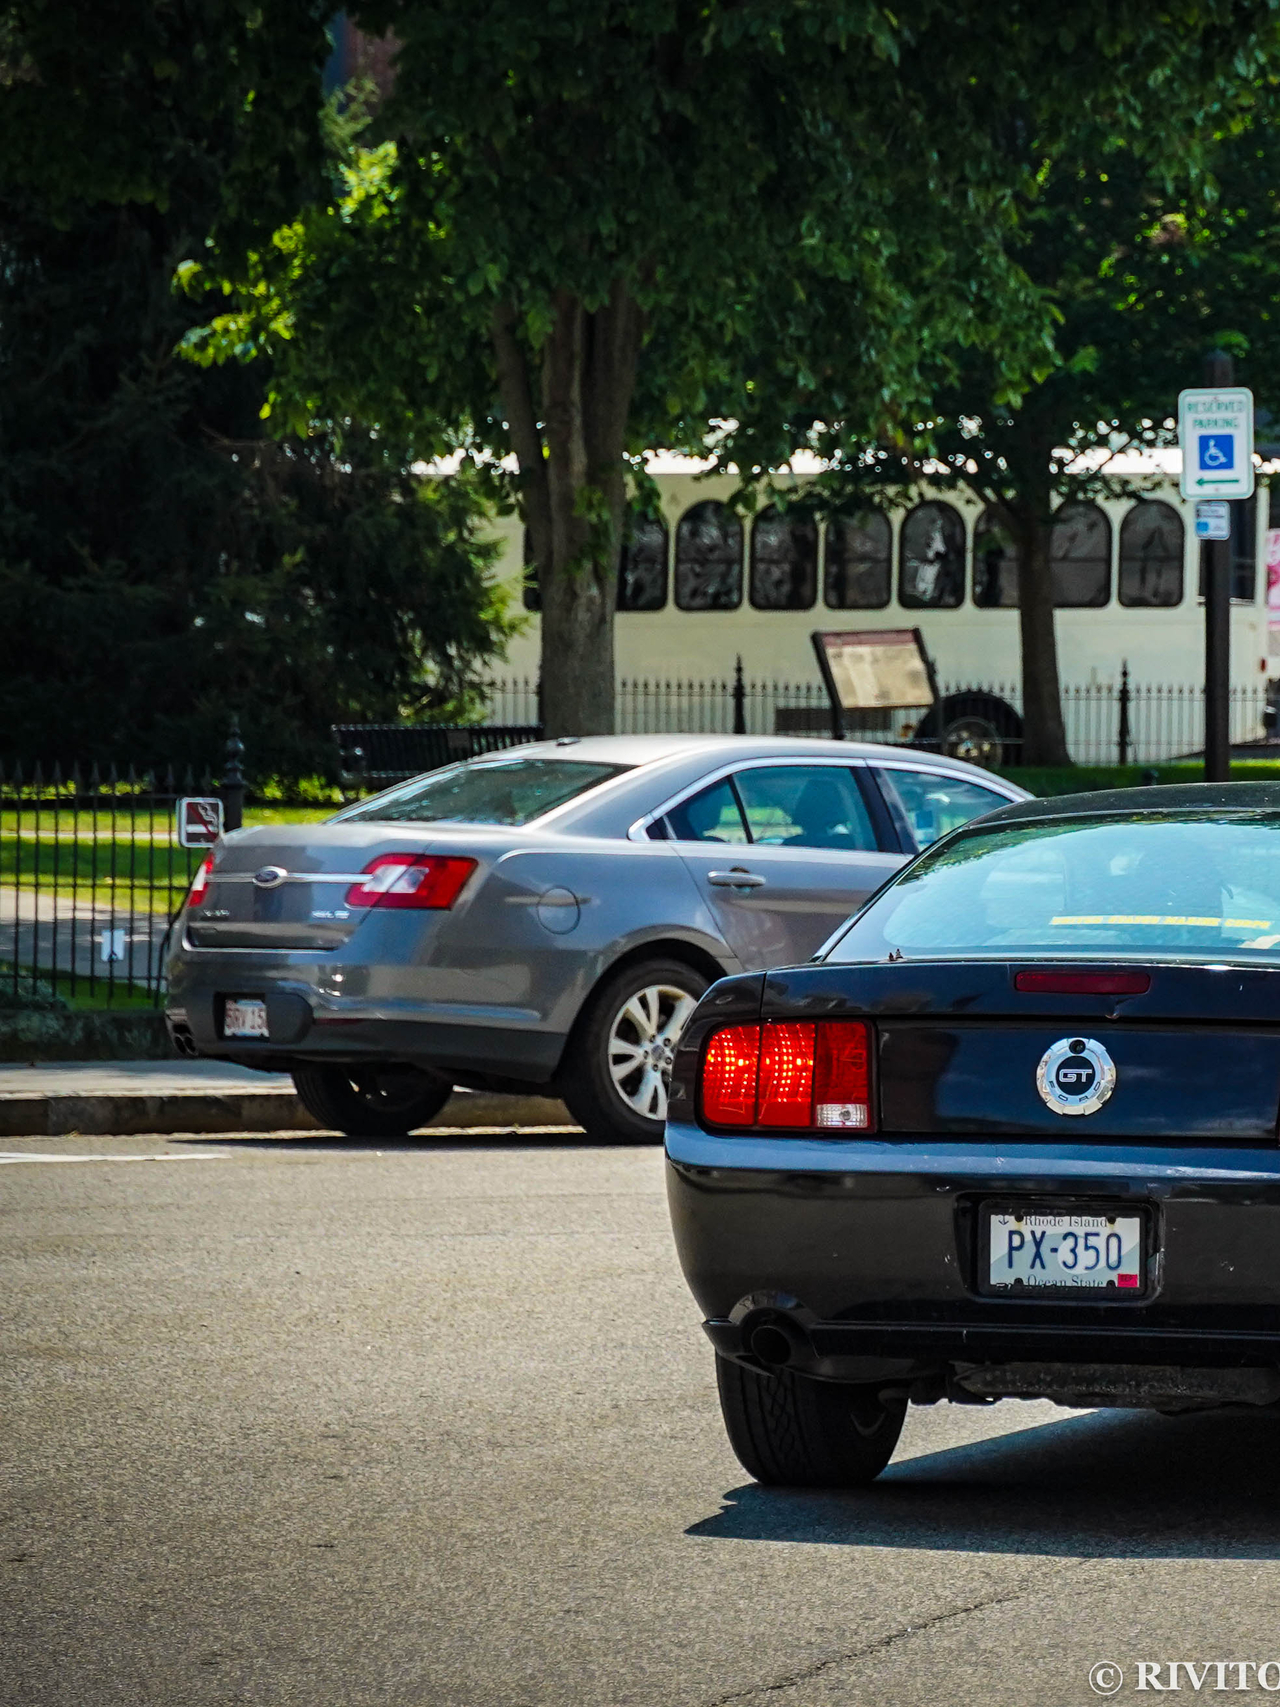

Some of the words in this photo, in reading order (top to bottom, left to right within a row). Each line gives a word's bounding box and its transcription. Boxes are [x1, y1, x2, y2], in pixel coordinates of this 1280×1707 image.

[1187, 401, 1244, 412] RESERVED
[1194, 417, 1239, 429] PARKING
[1059, 1068, 1093, 1083] GT
[1023, 1215, 1064, 1227] Rhode
[1069, 1216, 1108, 1228] Island
[1007, 1230, 1122, 1271] PX-350
